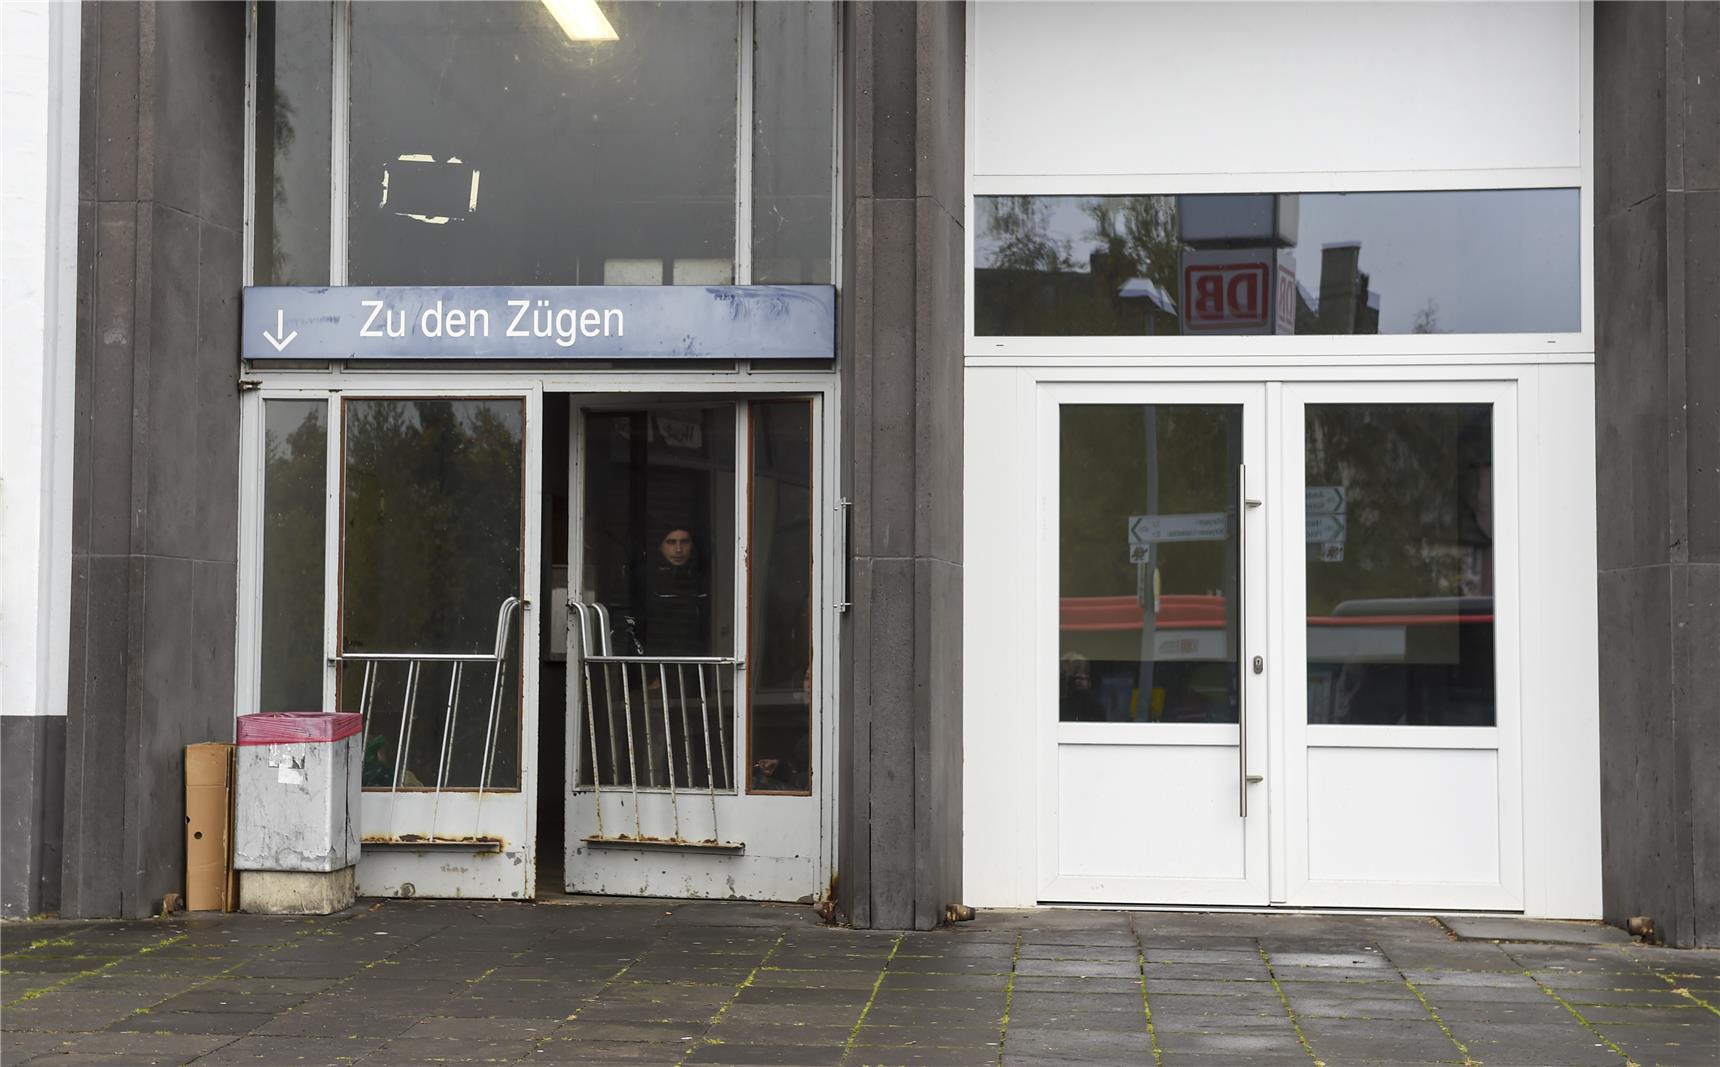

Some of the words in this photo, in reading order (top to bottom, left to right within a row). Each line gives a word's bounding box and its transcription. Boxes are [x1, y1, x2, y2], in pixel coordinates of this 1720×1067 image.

[359, 300, 405, 338] Zu
[421, 300, 489, 338] den
[506, 300, 624, 347] Zügen
